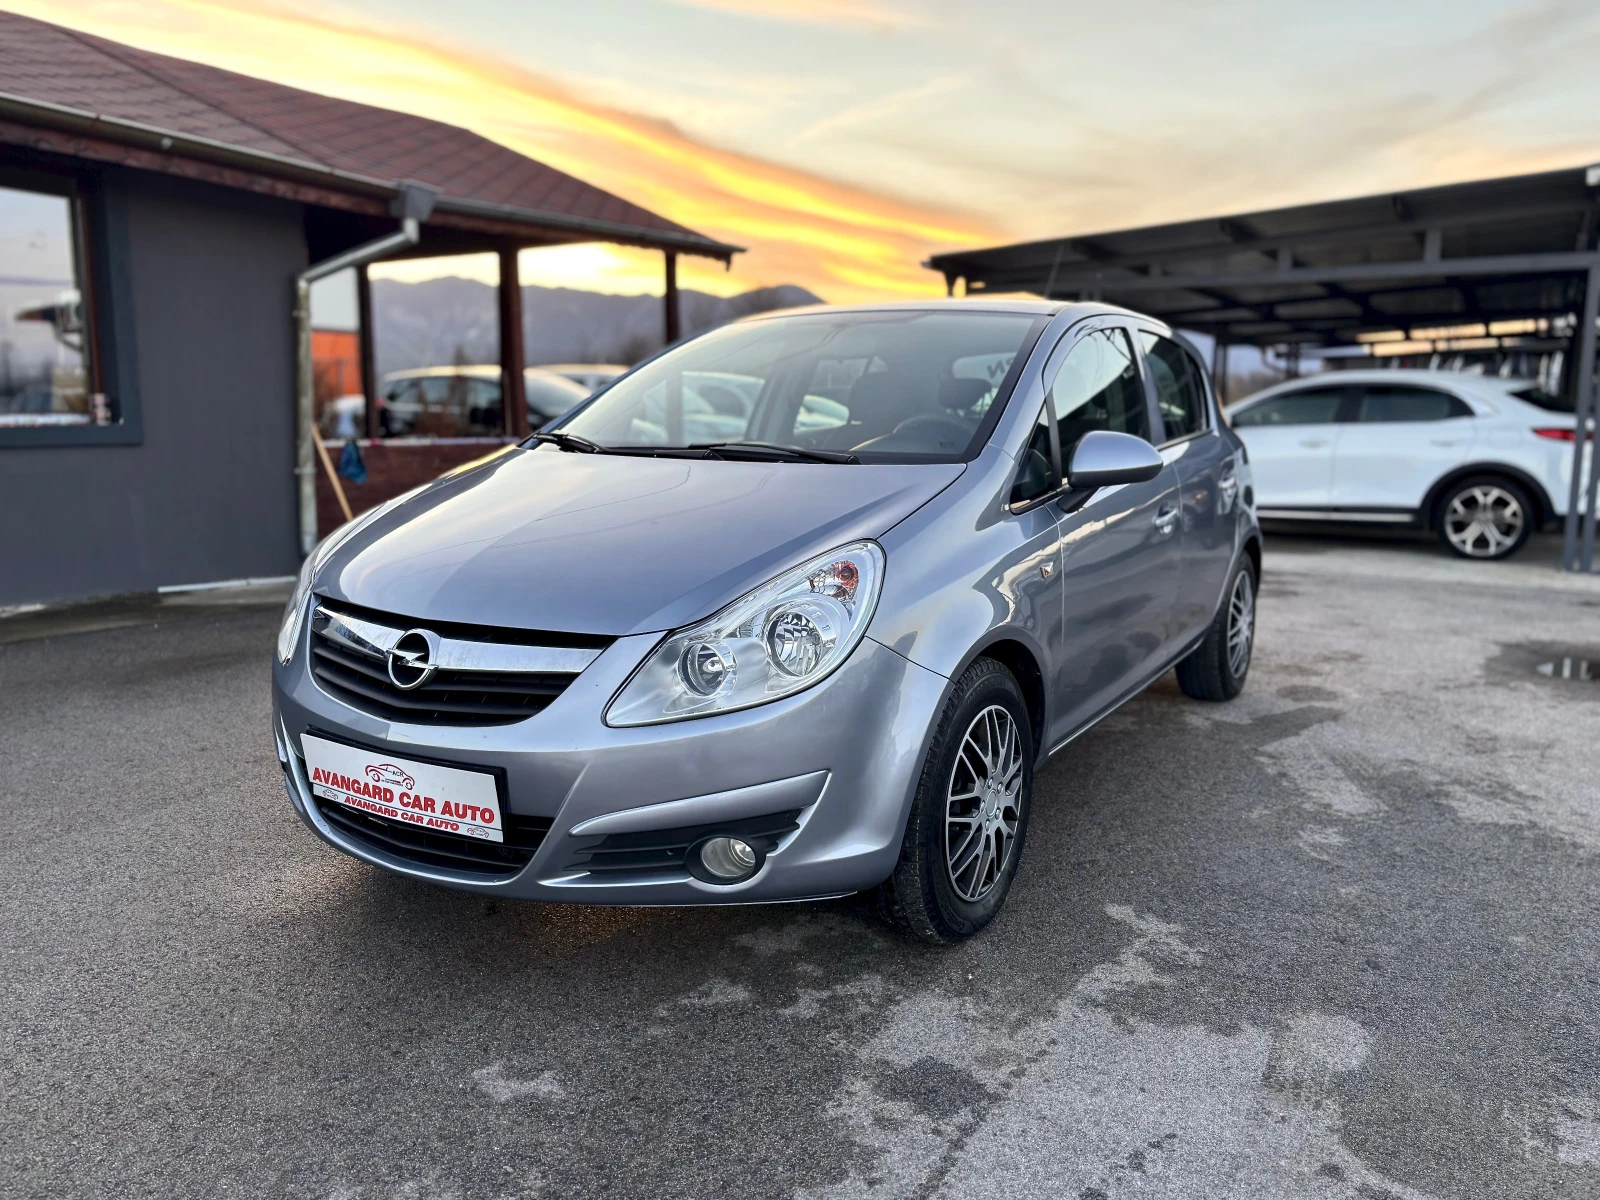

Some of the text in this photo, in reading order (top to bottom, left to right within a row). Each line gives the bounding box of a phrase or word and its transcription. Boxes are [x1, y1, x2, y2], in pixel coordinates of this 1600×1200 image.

[312, 767, 495, 824] AVANGARD CAR AUTO
[344, 795, 460, 832] AVANGARD CAR AUTO
